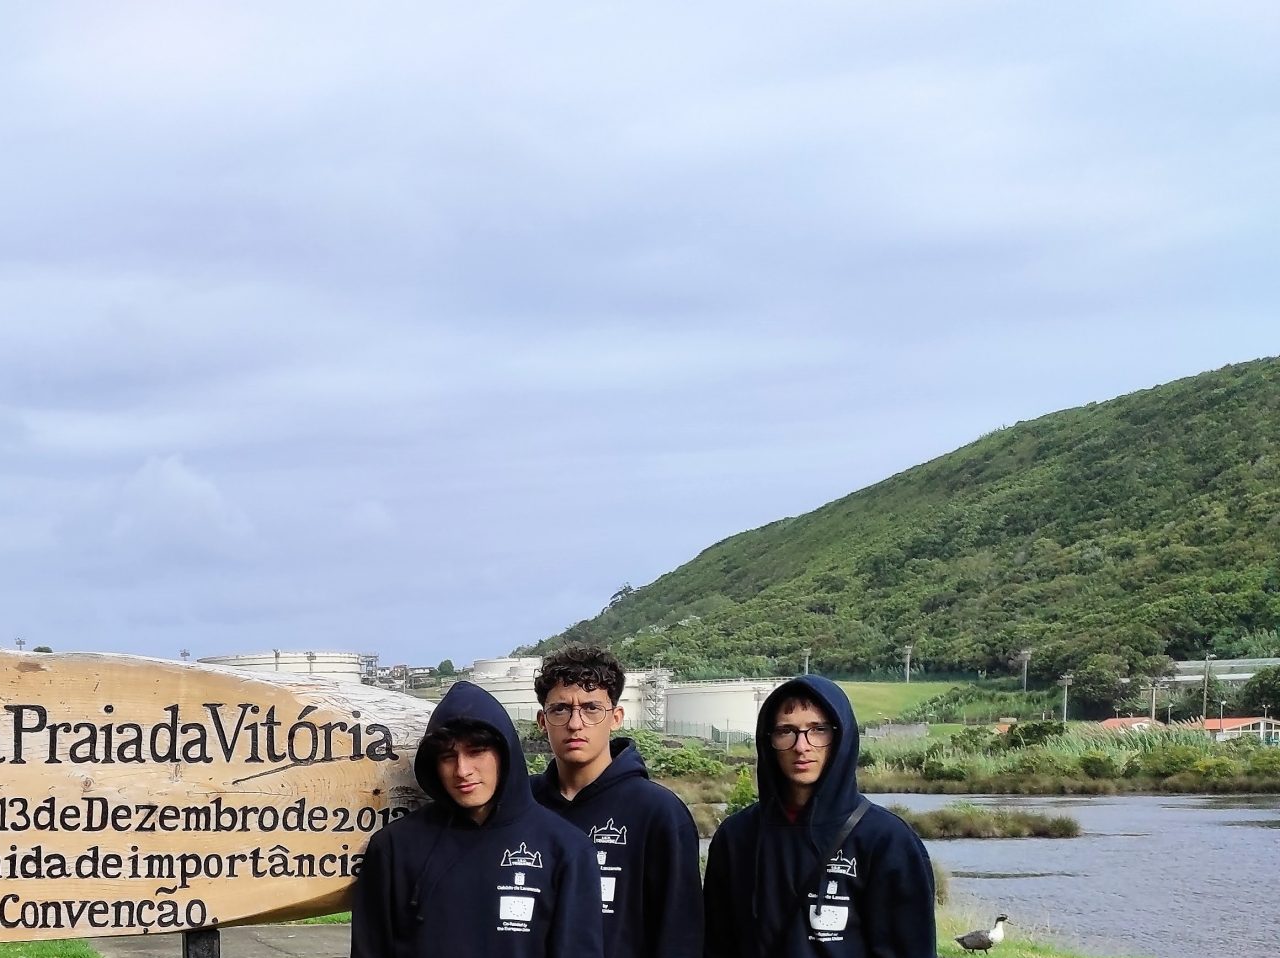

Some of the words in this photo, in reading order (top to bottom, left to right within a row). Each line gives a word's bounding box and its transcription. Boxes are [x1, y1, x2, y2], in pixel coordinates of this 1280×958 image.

[4, 704, 145, 765] Praia
[149, 703, 213, 764] da
[203, 703, 400, 765] Vitória
[33, 796, 80, 832] de
[81, 796, 279, 833] Dezembro
[282, 797, 328, 832] de
[75, 845, 122, 879] de
[0, 885, 219, 934] Convenção.
